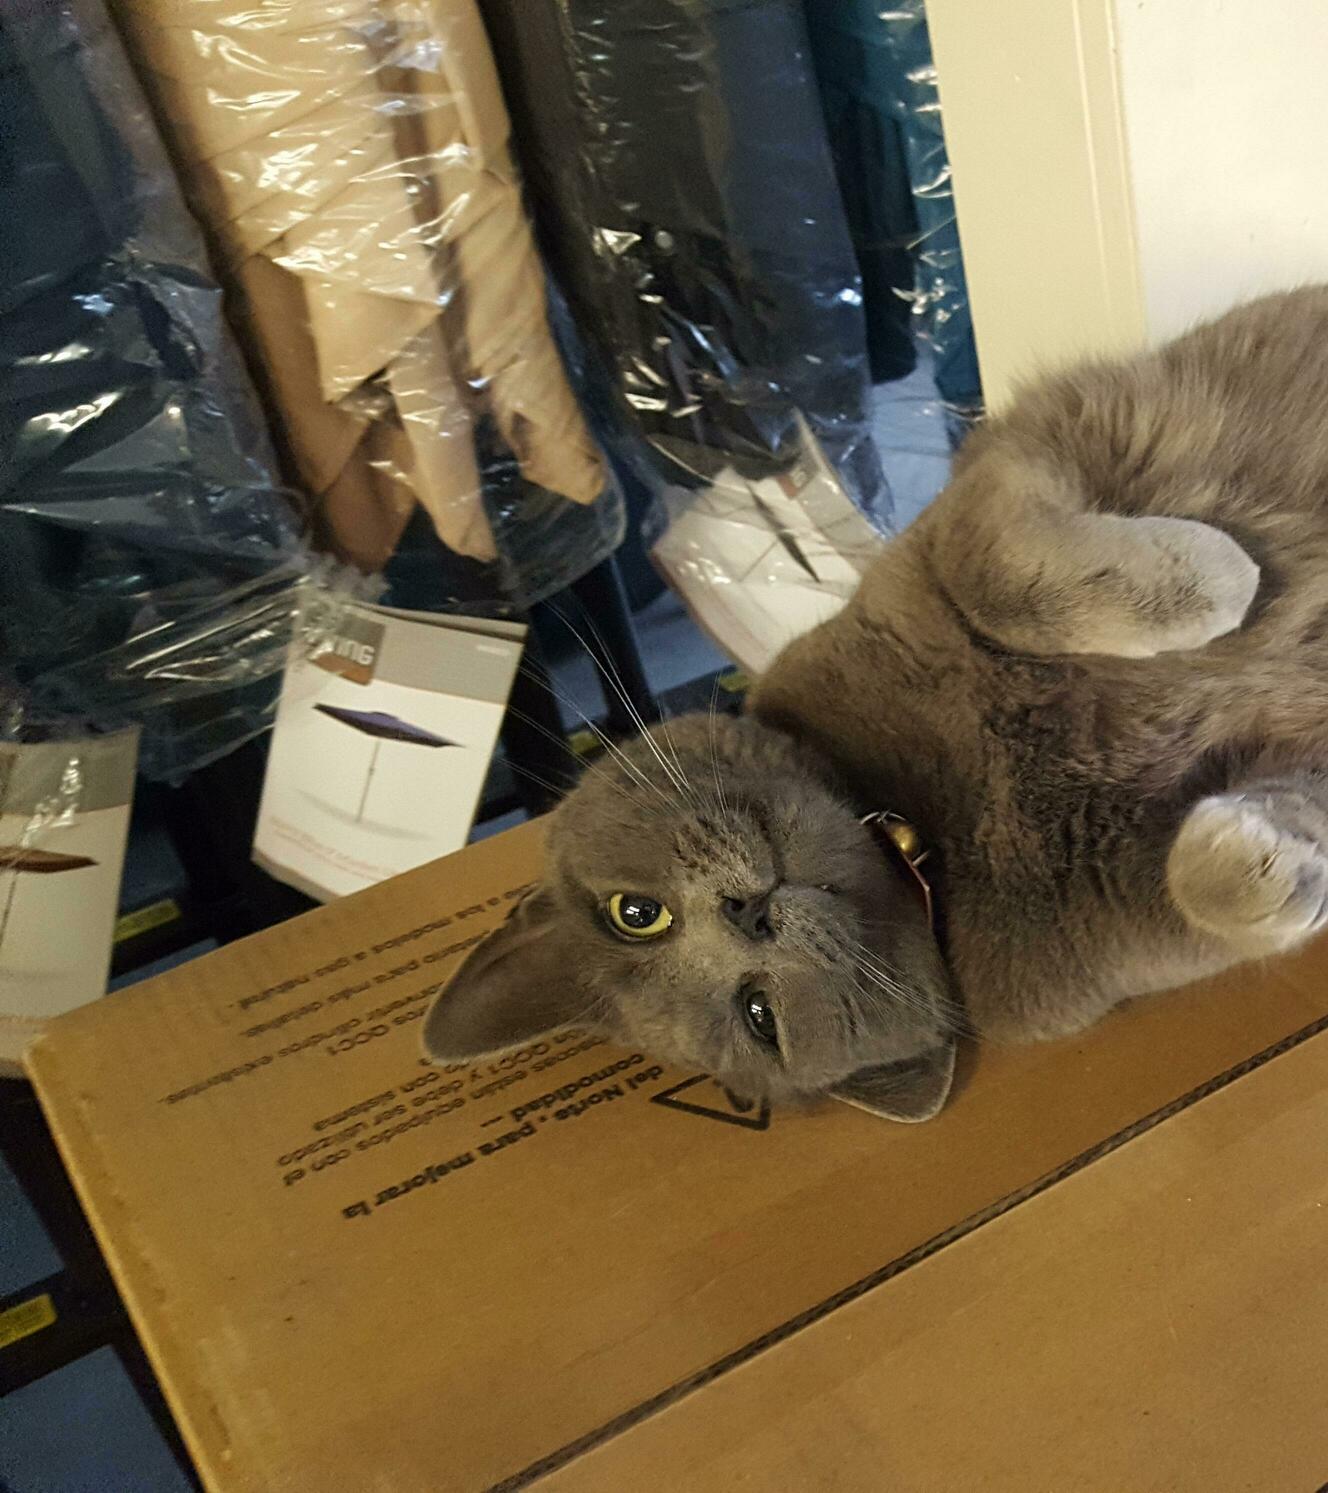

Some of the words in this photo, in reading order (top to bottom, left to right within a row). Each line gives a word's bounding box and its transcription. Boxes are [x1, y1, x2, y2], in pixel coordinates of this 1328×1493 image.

[454, 904, 486, 920] los
[486, 897, 500, 906] a
[371, 918, 452, 954] modelos
[313, 957, 351, 977] gas
[373, 960, 420, 984] para
[277, 1018, 362, 1057] cilindros
[326, 1024, 390, 1056] QCC1
[488, 1042, 551, 1075] QCC1
[400, 1072, 440, 1093] con
[470, 1068, 483, 1083] y
[510, 1053, 645, 1122] comodidad
[625, 1065, 664, 1090] del
[412, 1079, 464, 1107] debe
[554, 1084, 625, 1120] Norte
[313, 1090, 397, 1132] sistema
[355, 1097, 466, 1151] equipados
[373, 1104, 407, 1126] ser
[277, 1122, 369, 1166] utilizado
[477, 1121, 537, 1156] para
[311, 1149, 350, 1172] con
[375, 1152, 476, 1206] mejorar
[342, 1201, 371, 1219] la
